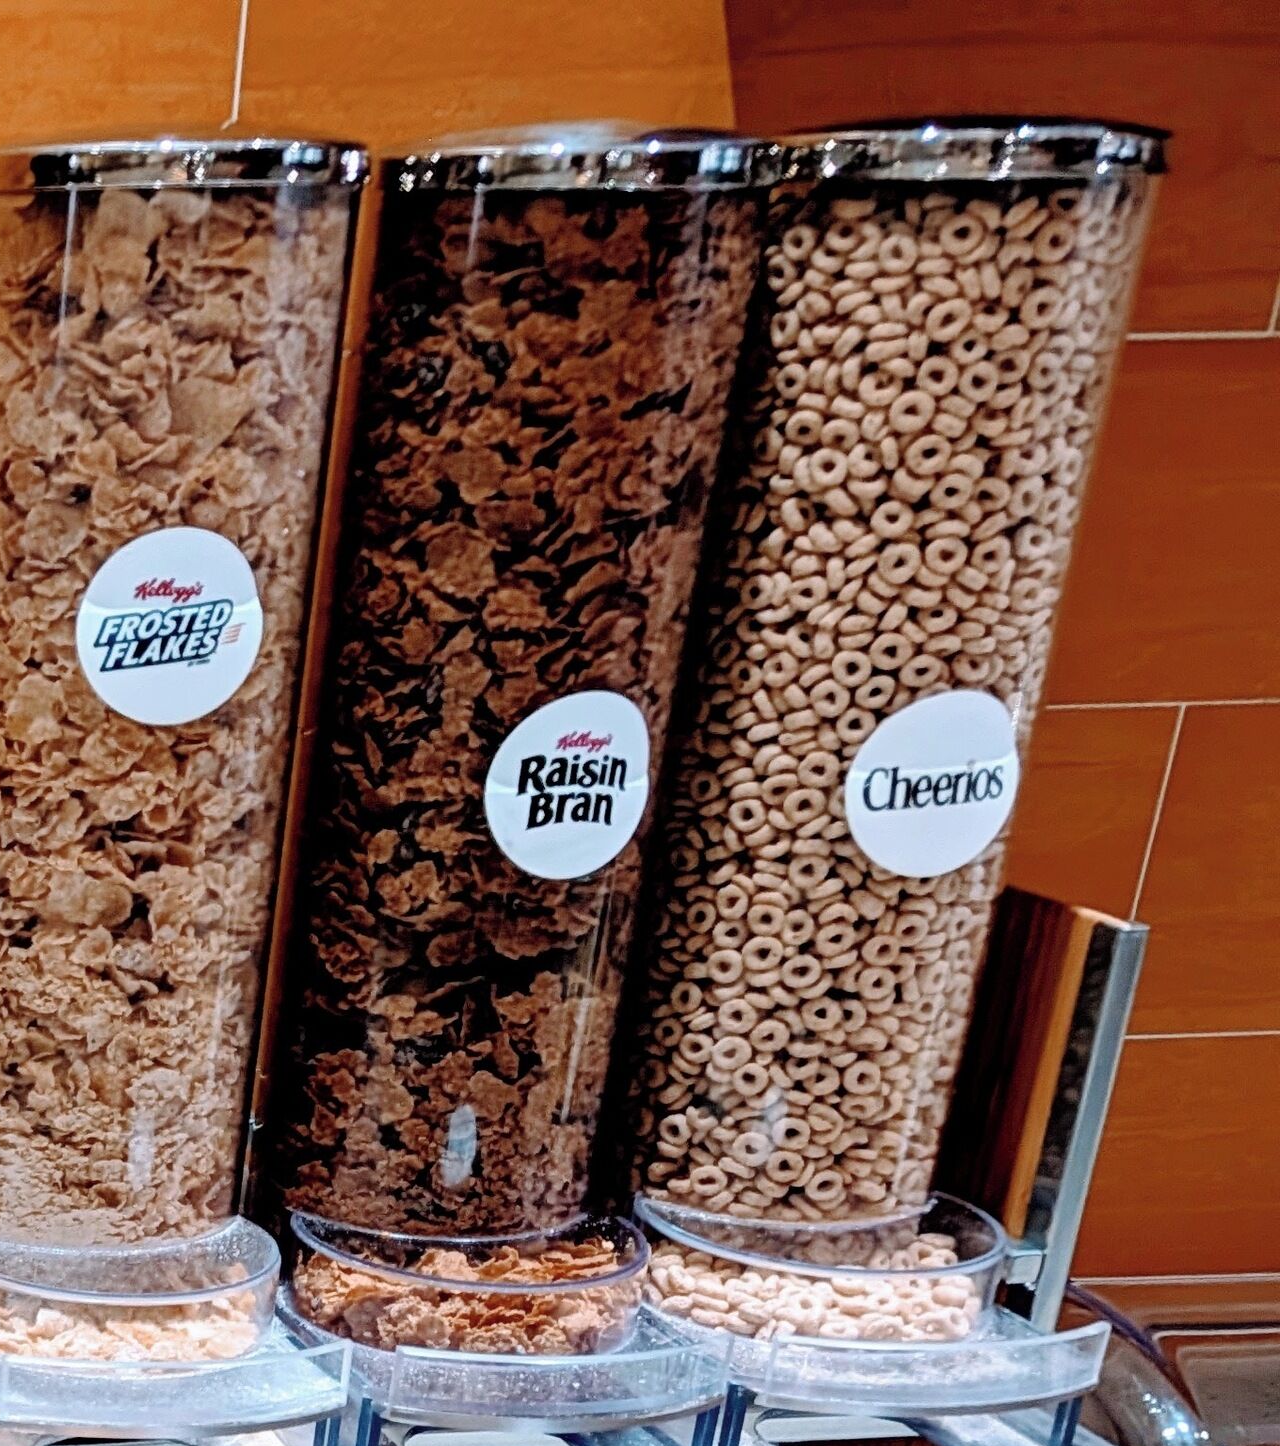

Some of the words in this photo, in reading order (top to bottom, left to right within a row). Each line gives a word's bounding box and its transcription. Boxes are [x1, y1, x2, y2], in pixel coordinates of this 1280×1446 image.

[134, 577, 204, 604] Kellogg's
[95, 599, 234, 648] FROSTED
[101, 629, 221, 672] FLAKES
[517, 754, 628, 796] Raisin
[862, 759, 1004, 812] Cheerios
[526, 792, 614, 831] Bran
